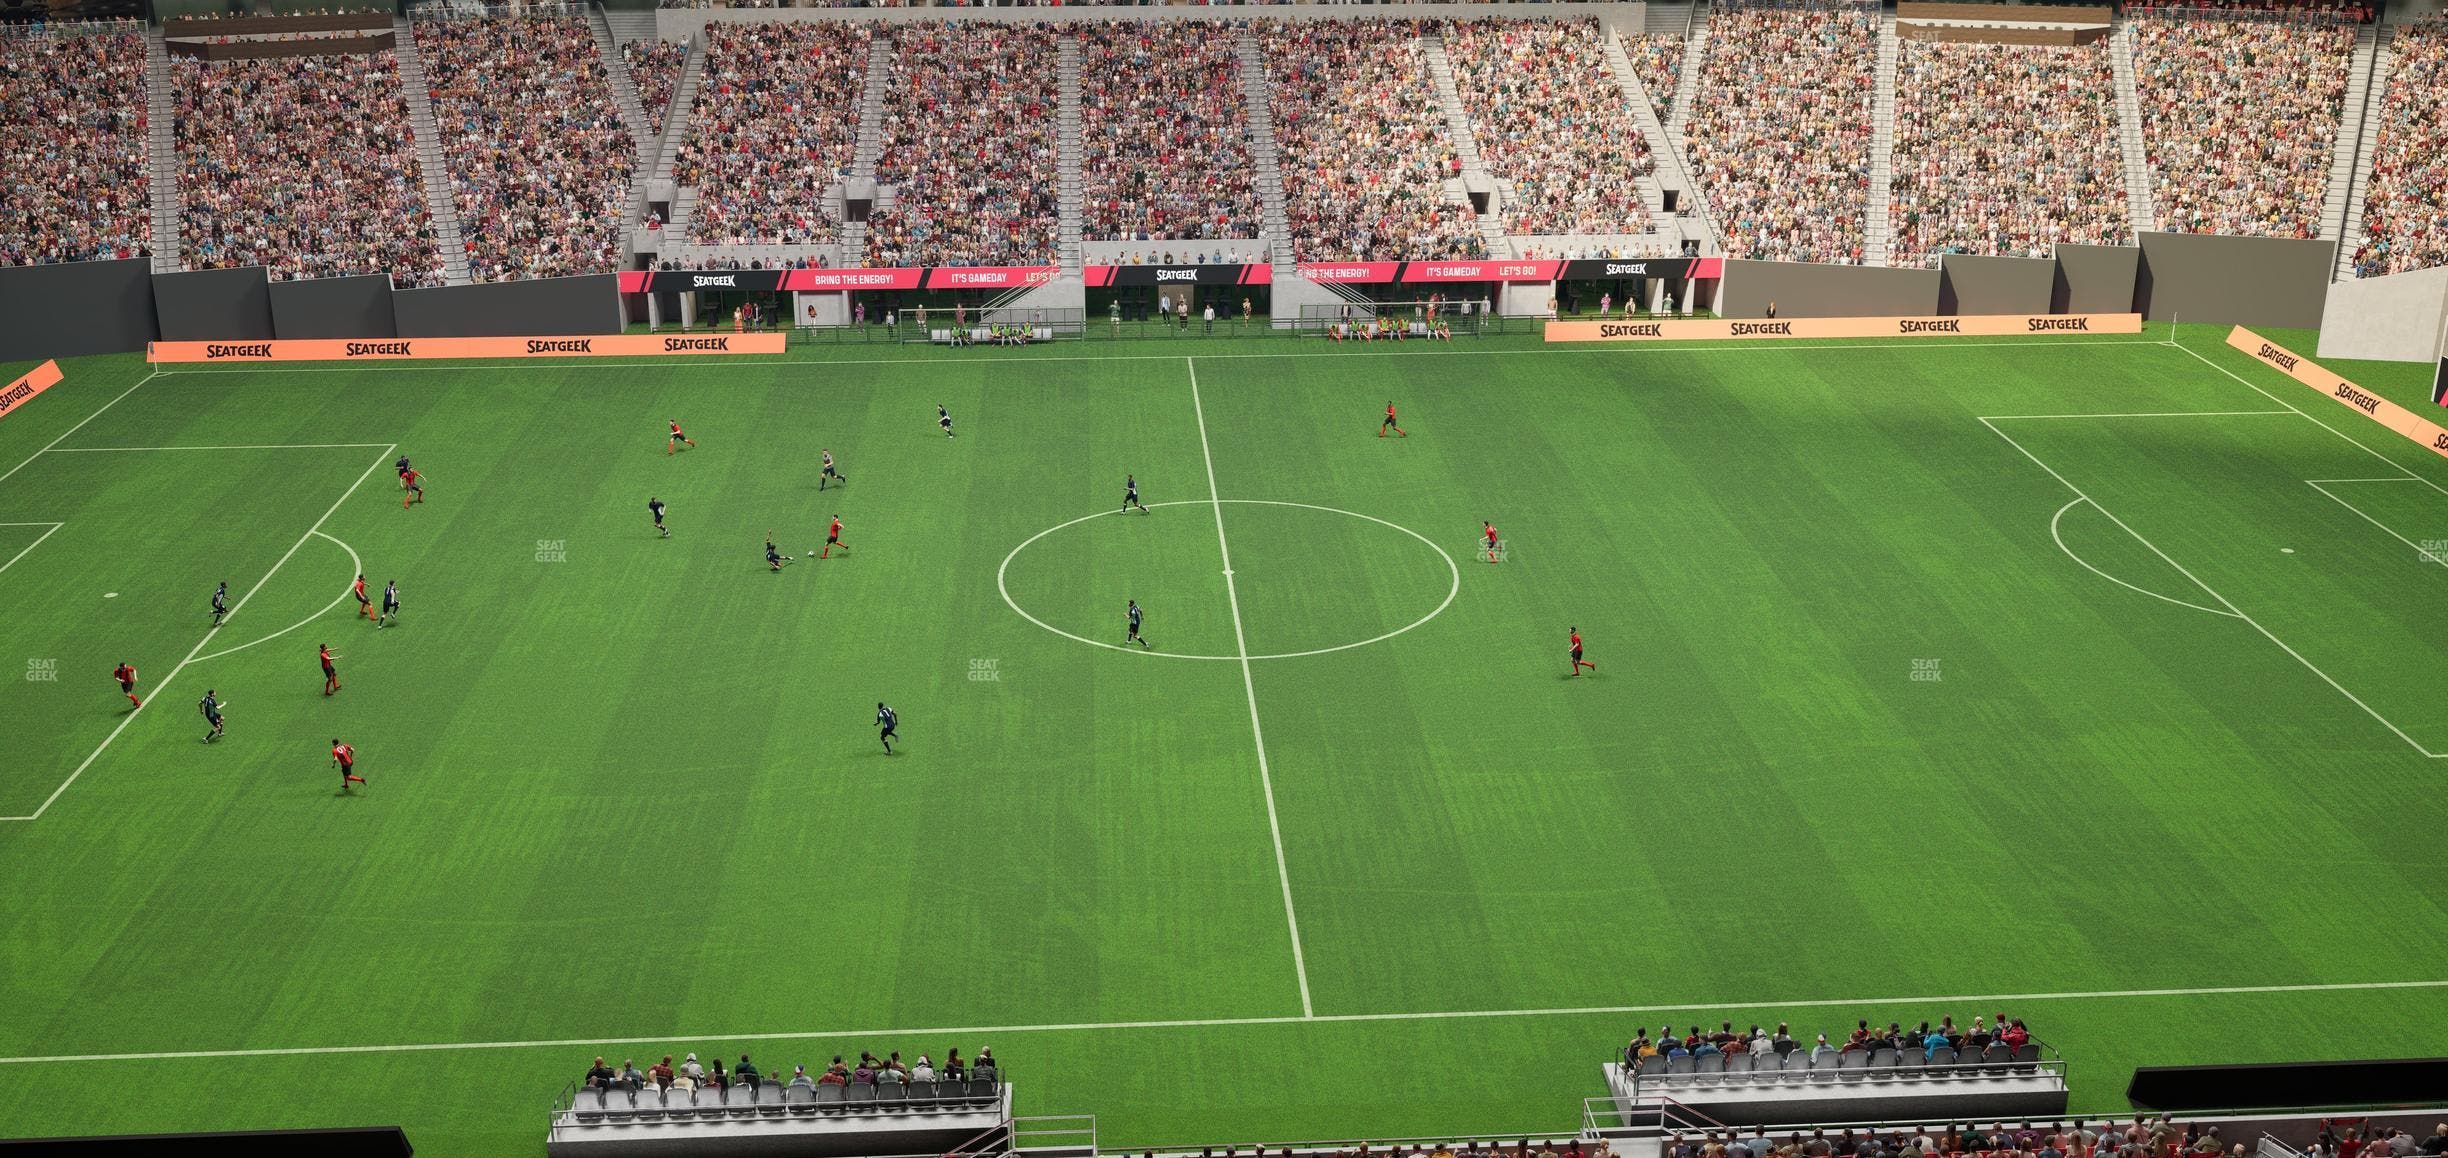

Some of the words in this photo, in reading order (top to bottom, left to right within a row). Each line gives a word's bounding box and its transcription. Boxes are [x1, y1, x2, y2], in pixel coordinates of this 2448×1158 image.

[1156, 269, 1198, 281] SEATGEEK
[1336, 268, 1370, 278] ENERGY!
[1427, 267, 1441, 277] IT'S
[1443, 267, 1481, 276] GAMEDAY
[1500, 266, 1521, 276] LET'S
[1522, 265, 1537, 276] GO!
[1606, 263, 1647, 275] SEATGEEK
[693, 275, 736, 287] SEATGEEK
[815, 275, 841, 284] BRING
[842, 275, 858, 284] THE
[859, 274, 894, 284] ENERGY!
[951, 273, 967, 283] IT'S
[968, 273, 1007, 282] GAMEDAY
[1600, 323, 1662, 338] SEATGEEK
[1730, 321, 1792, 336] SEATGEEK
[1899, 319, 1961, 334] SEATGEEK
[2028, 317, 2089, 332] SEATGEEK
[206, 343, 273, 358] SEATGEEK
[346, 341, 412, 356] SEATGEEK
[527, 338, 592, 354] SEATGEEK
[664, 336, 729, 352] SEATGEEK
[2257, 343, 2299, 373] SEATGEEK
[2335, 382, 2382, 416] SEATGEEK
